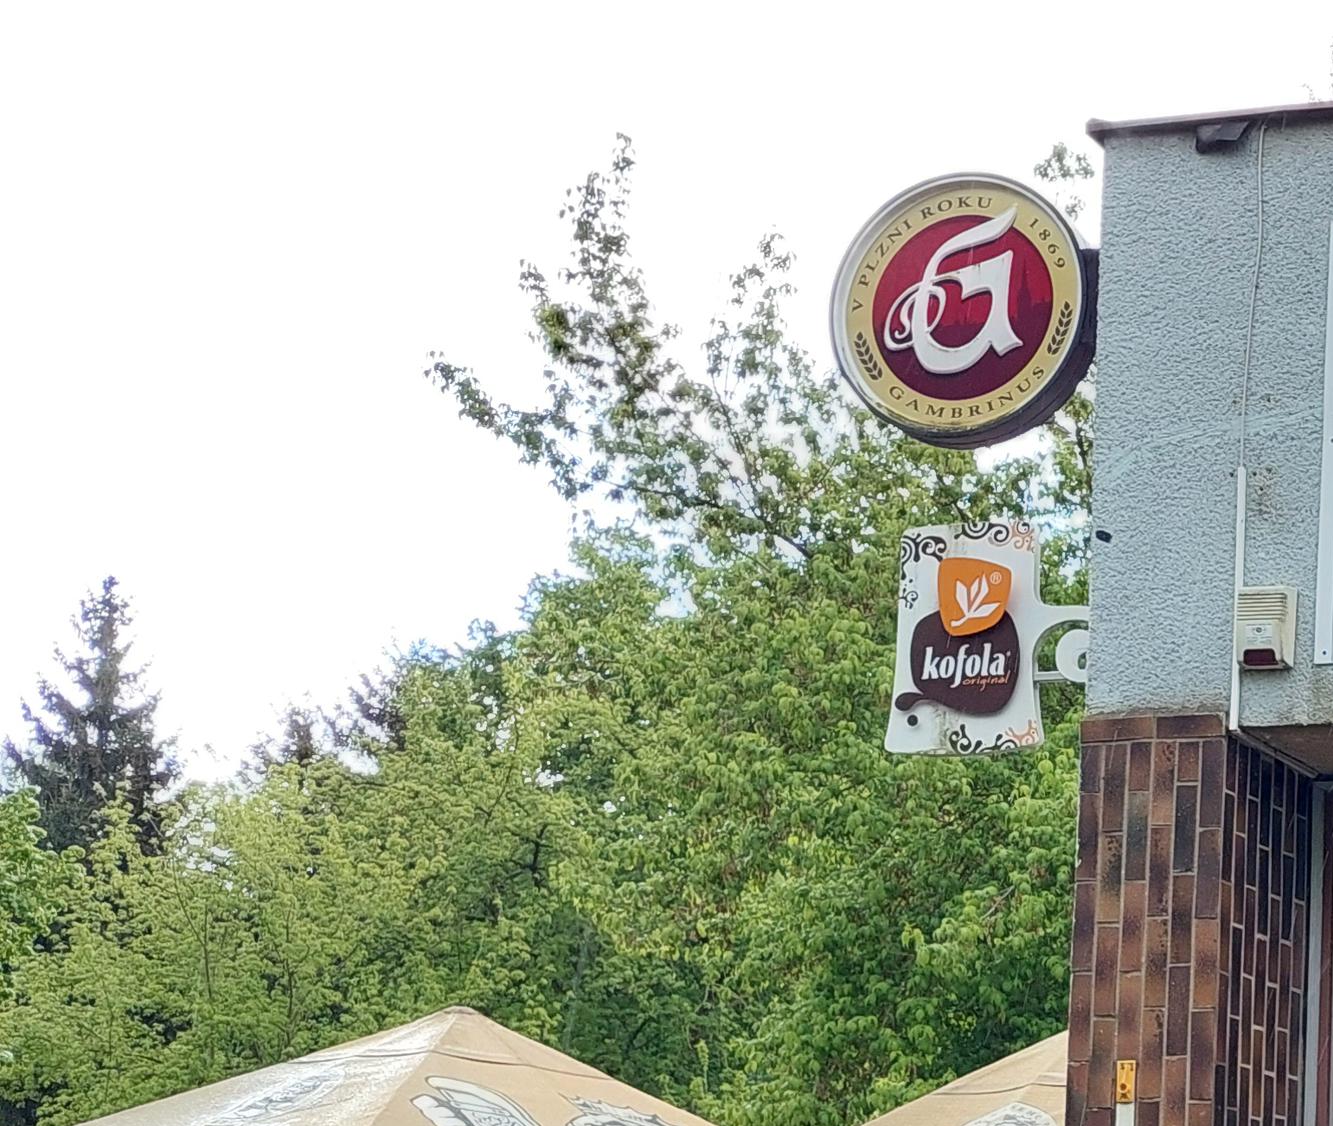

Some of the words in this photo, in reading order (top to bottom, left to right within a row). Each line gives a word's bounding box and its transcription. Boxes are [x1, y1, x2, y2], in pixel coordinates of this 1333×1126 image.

[851, 299, 863, 313] V
[859, 221, 912, 288] PLZNI
[920, 196, 992, 220] ROKU
[1028, 217, 1066, 269] 1869
[889, 365, 1045, 419] GAMBRINUS
[921, 643, 1005, 689] kofola
[962, 672, 1011, 691] original
